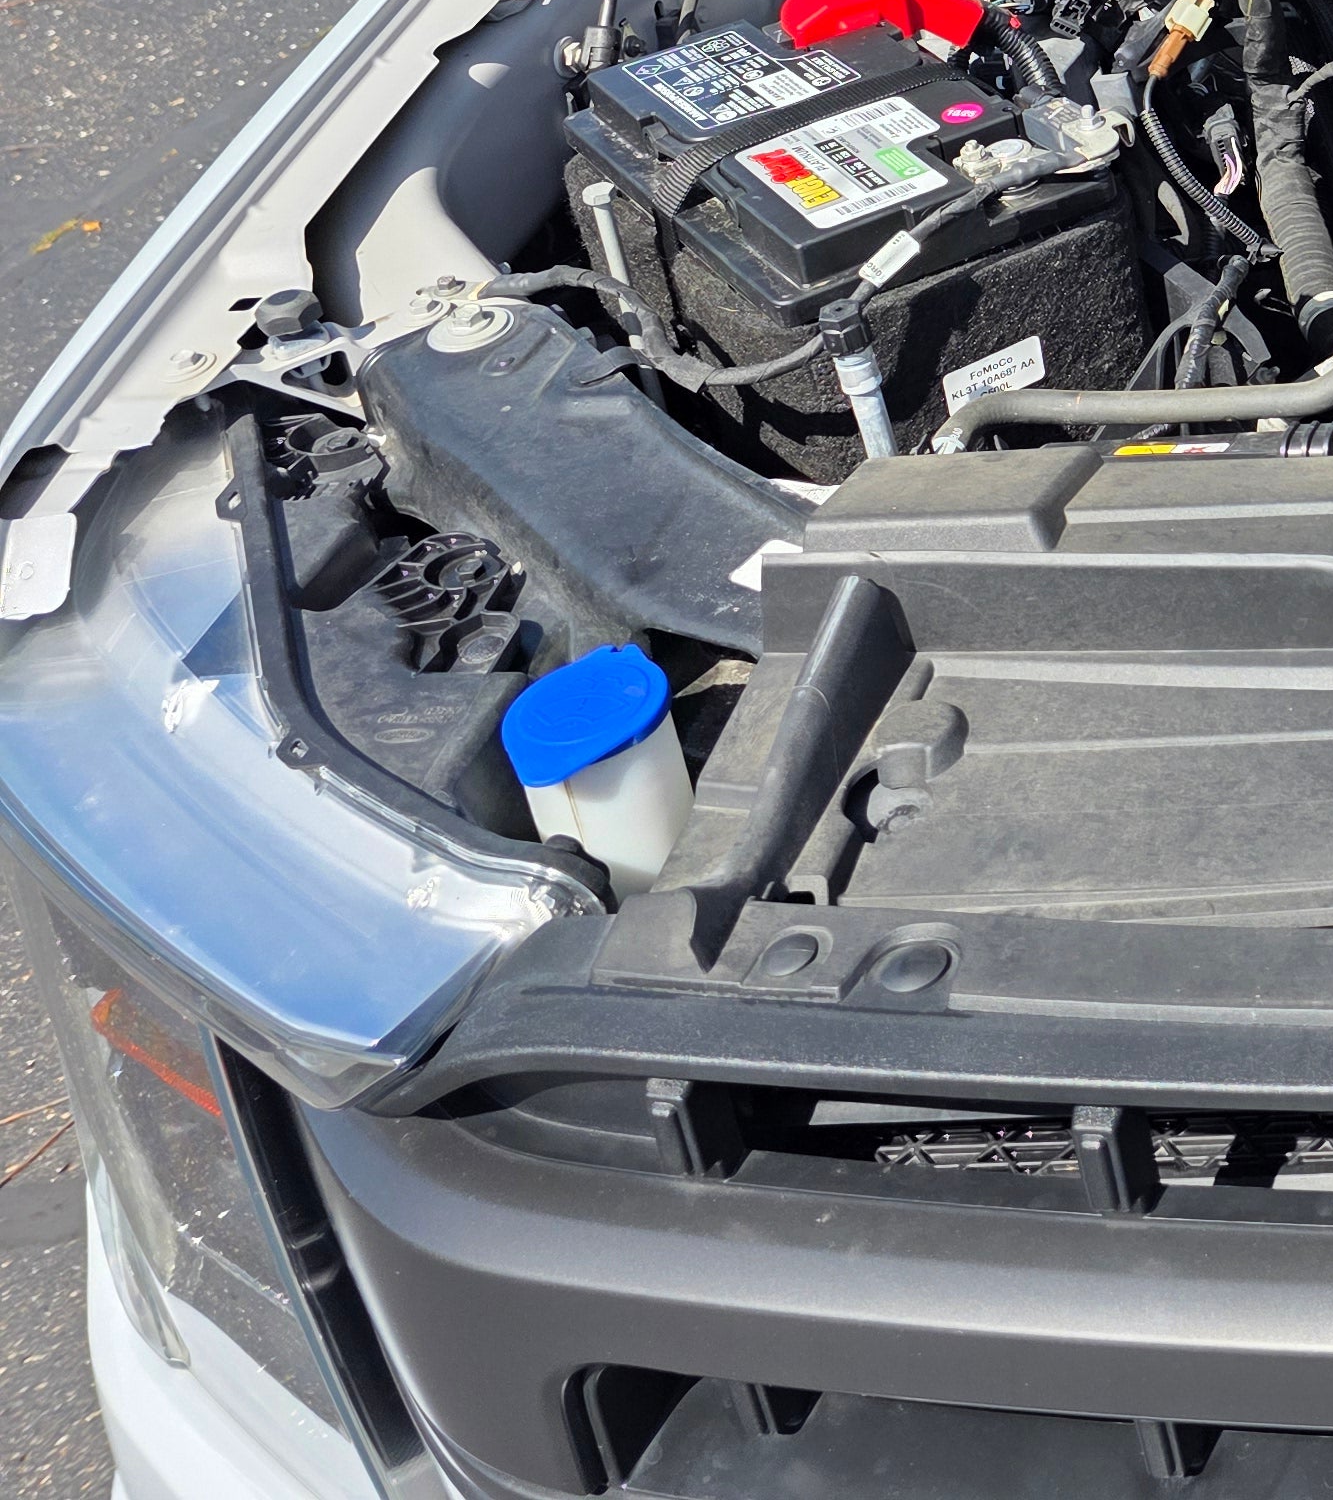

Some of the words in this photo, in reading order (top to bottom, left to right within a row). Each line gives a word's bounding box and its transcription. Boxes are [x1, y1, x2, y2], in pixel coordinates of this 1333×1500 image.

[952, 382, 979, 400] KL3T
[981, 364, 1018, 388] 10A687
[1020, 357, 1036, 370] AA
[970, 356, 1013, 380] FoMoCo
